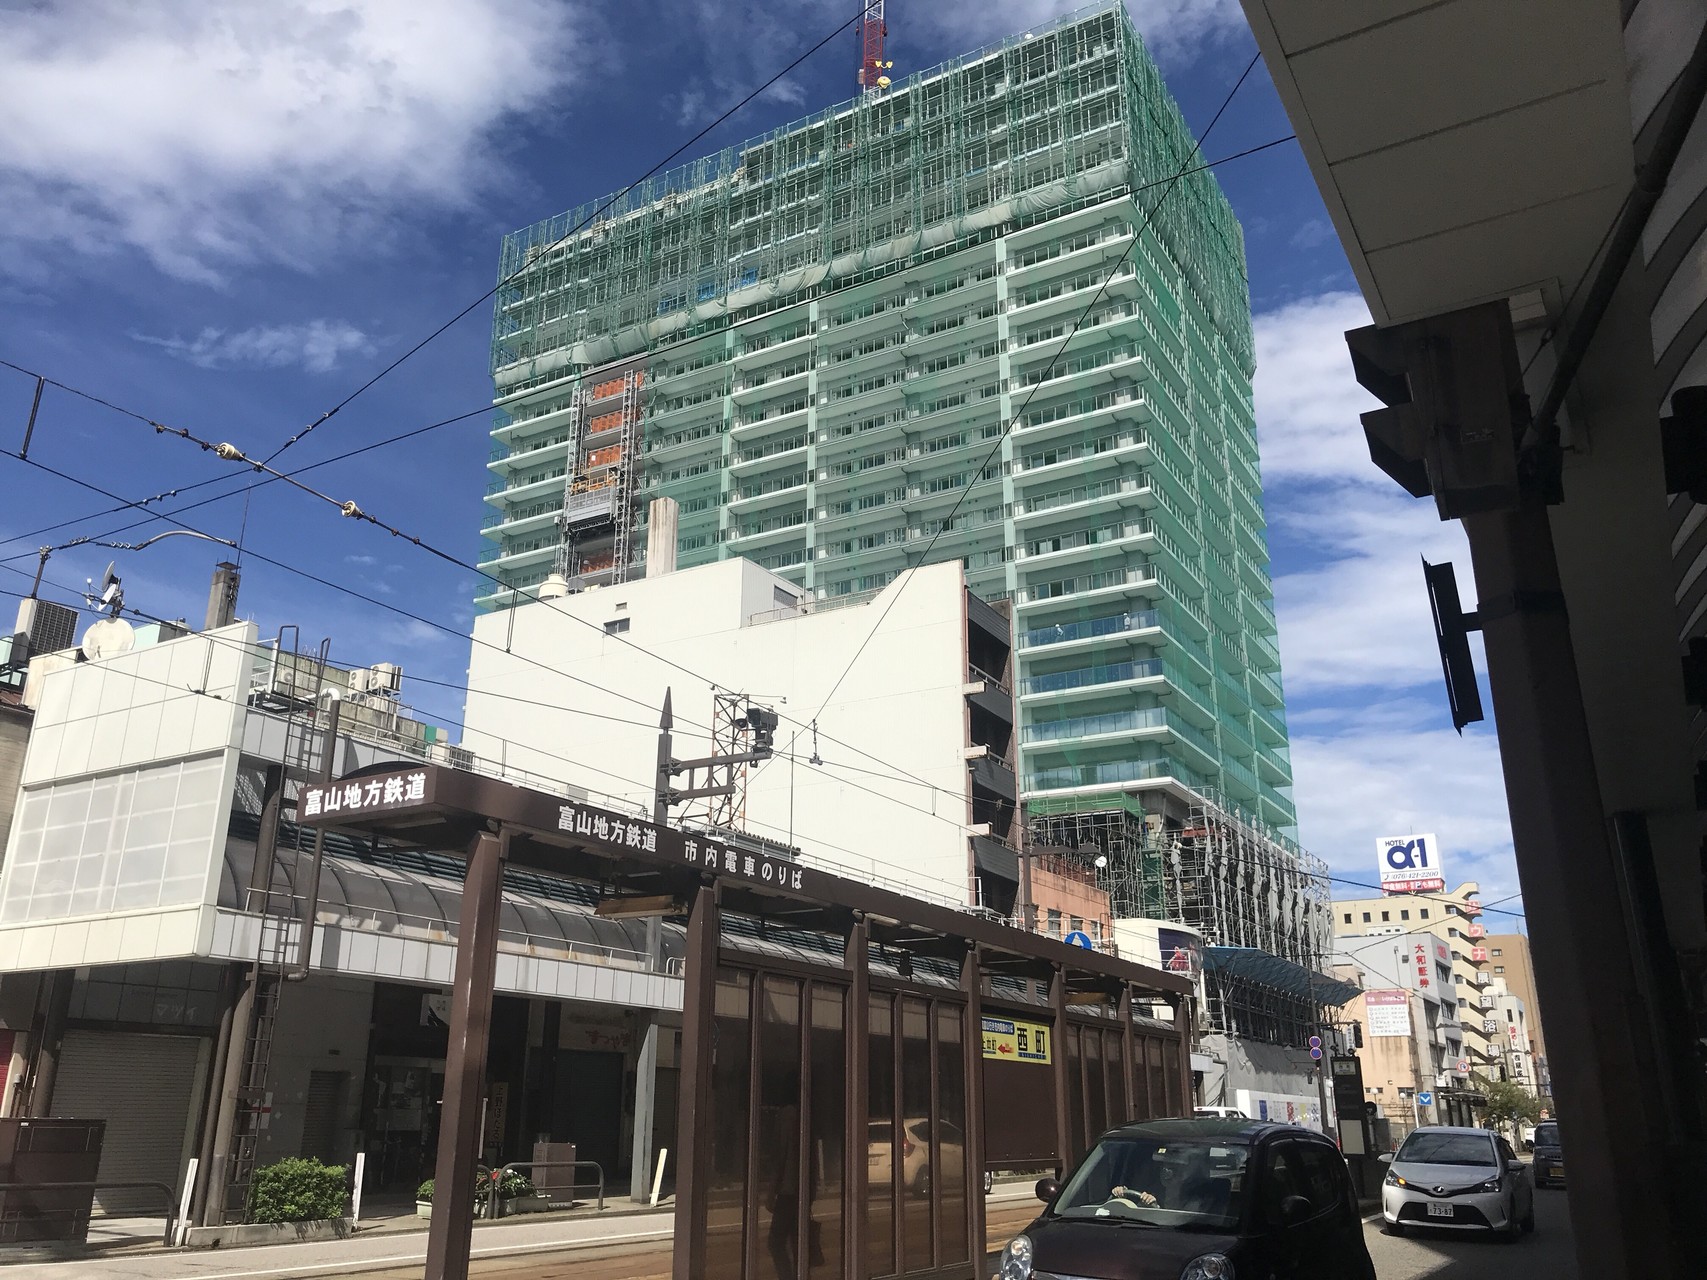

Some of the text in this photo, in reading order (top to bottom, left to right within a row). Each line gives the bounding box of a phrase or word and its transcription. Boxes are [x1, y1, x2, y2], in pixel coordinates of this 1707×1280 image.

[304, 772, 427, 816] 富山地方鉄道
[557, 805, 803, 890] 富山地方鉄道 市内電車のりば
[1414, 944, 1430, 989] 大和証券
[1017, 1027, 1045, 1054] 西町
